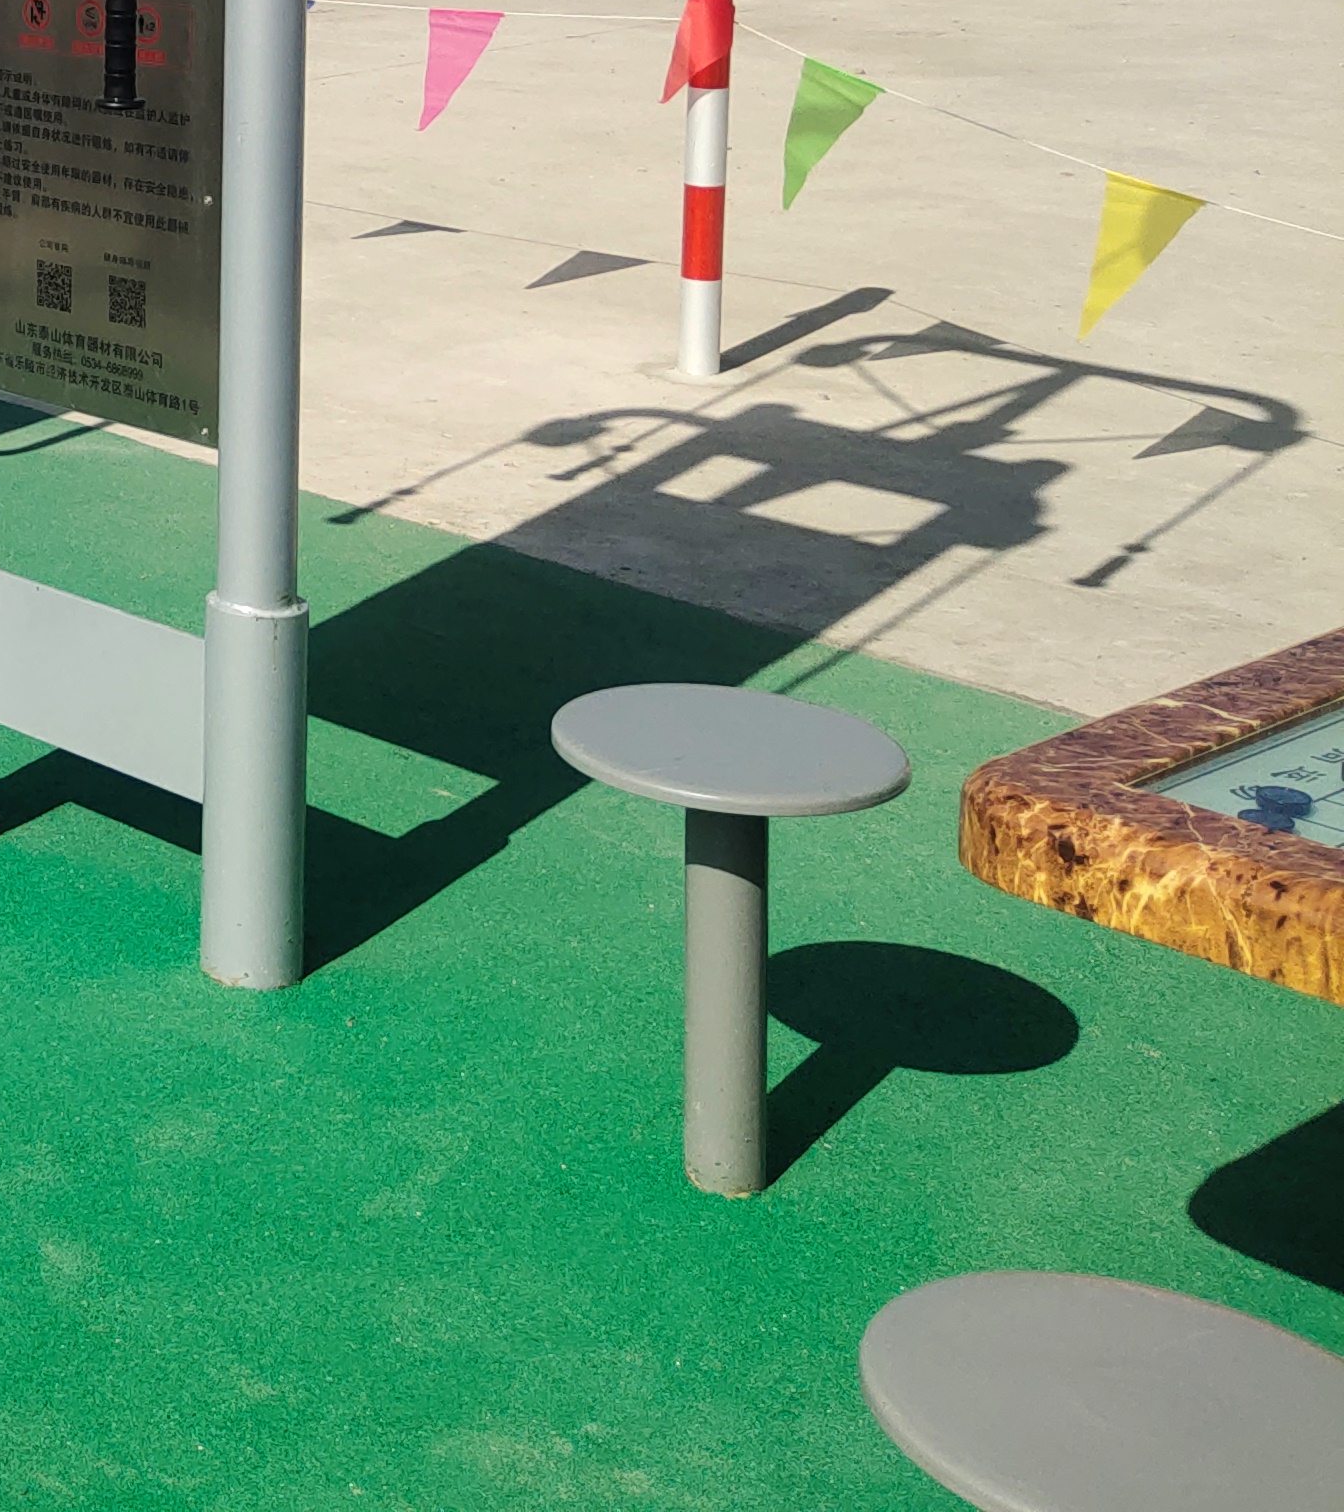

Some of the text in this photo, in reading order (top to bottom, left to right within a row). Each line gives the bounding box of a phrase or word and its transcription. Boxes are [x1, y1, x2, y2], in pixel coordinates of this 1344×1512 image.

[15, 318, 164, 369] 山东泰山体育器材有限公司
